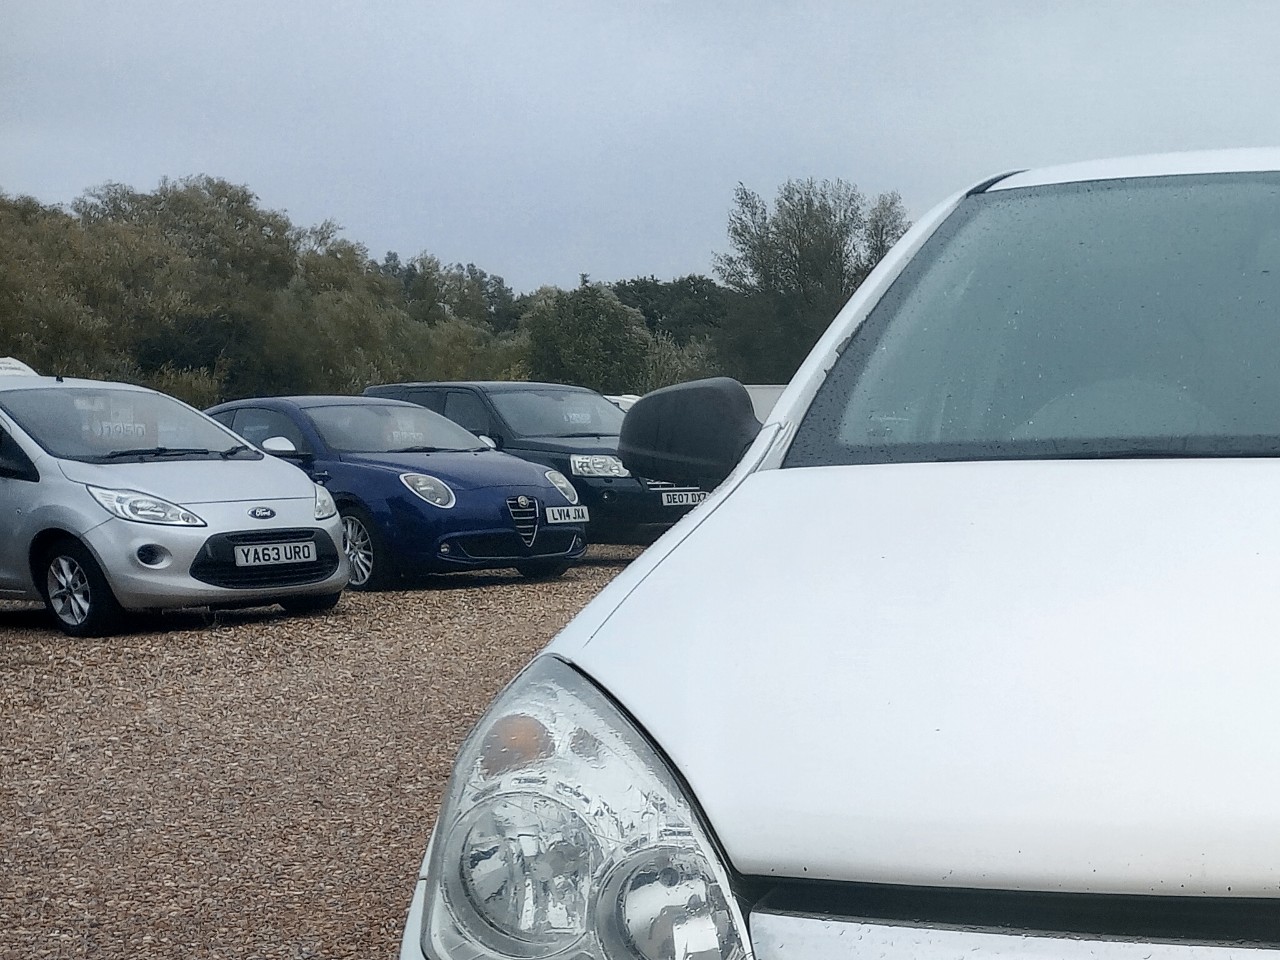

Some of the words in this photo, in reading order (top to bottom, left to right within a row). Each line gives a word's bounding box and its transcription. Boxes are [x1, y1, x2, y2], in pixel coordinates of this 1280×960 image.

[666, 493, 689, 504] DE07
[551, 508, 570, 521] LV14
[241, 547, 281, 563] YA63
[283, 545, 311, 560] URO
